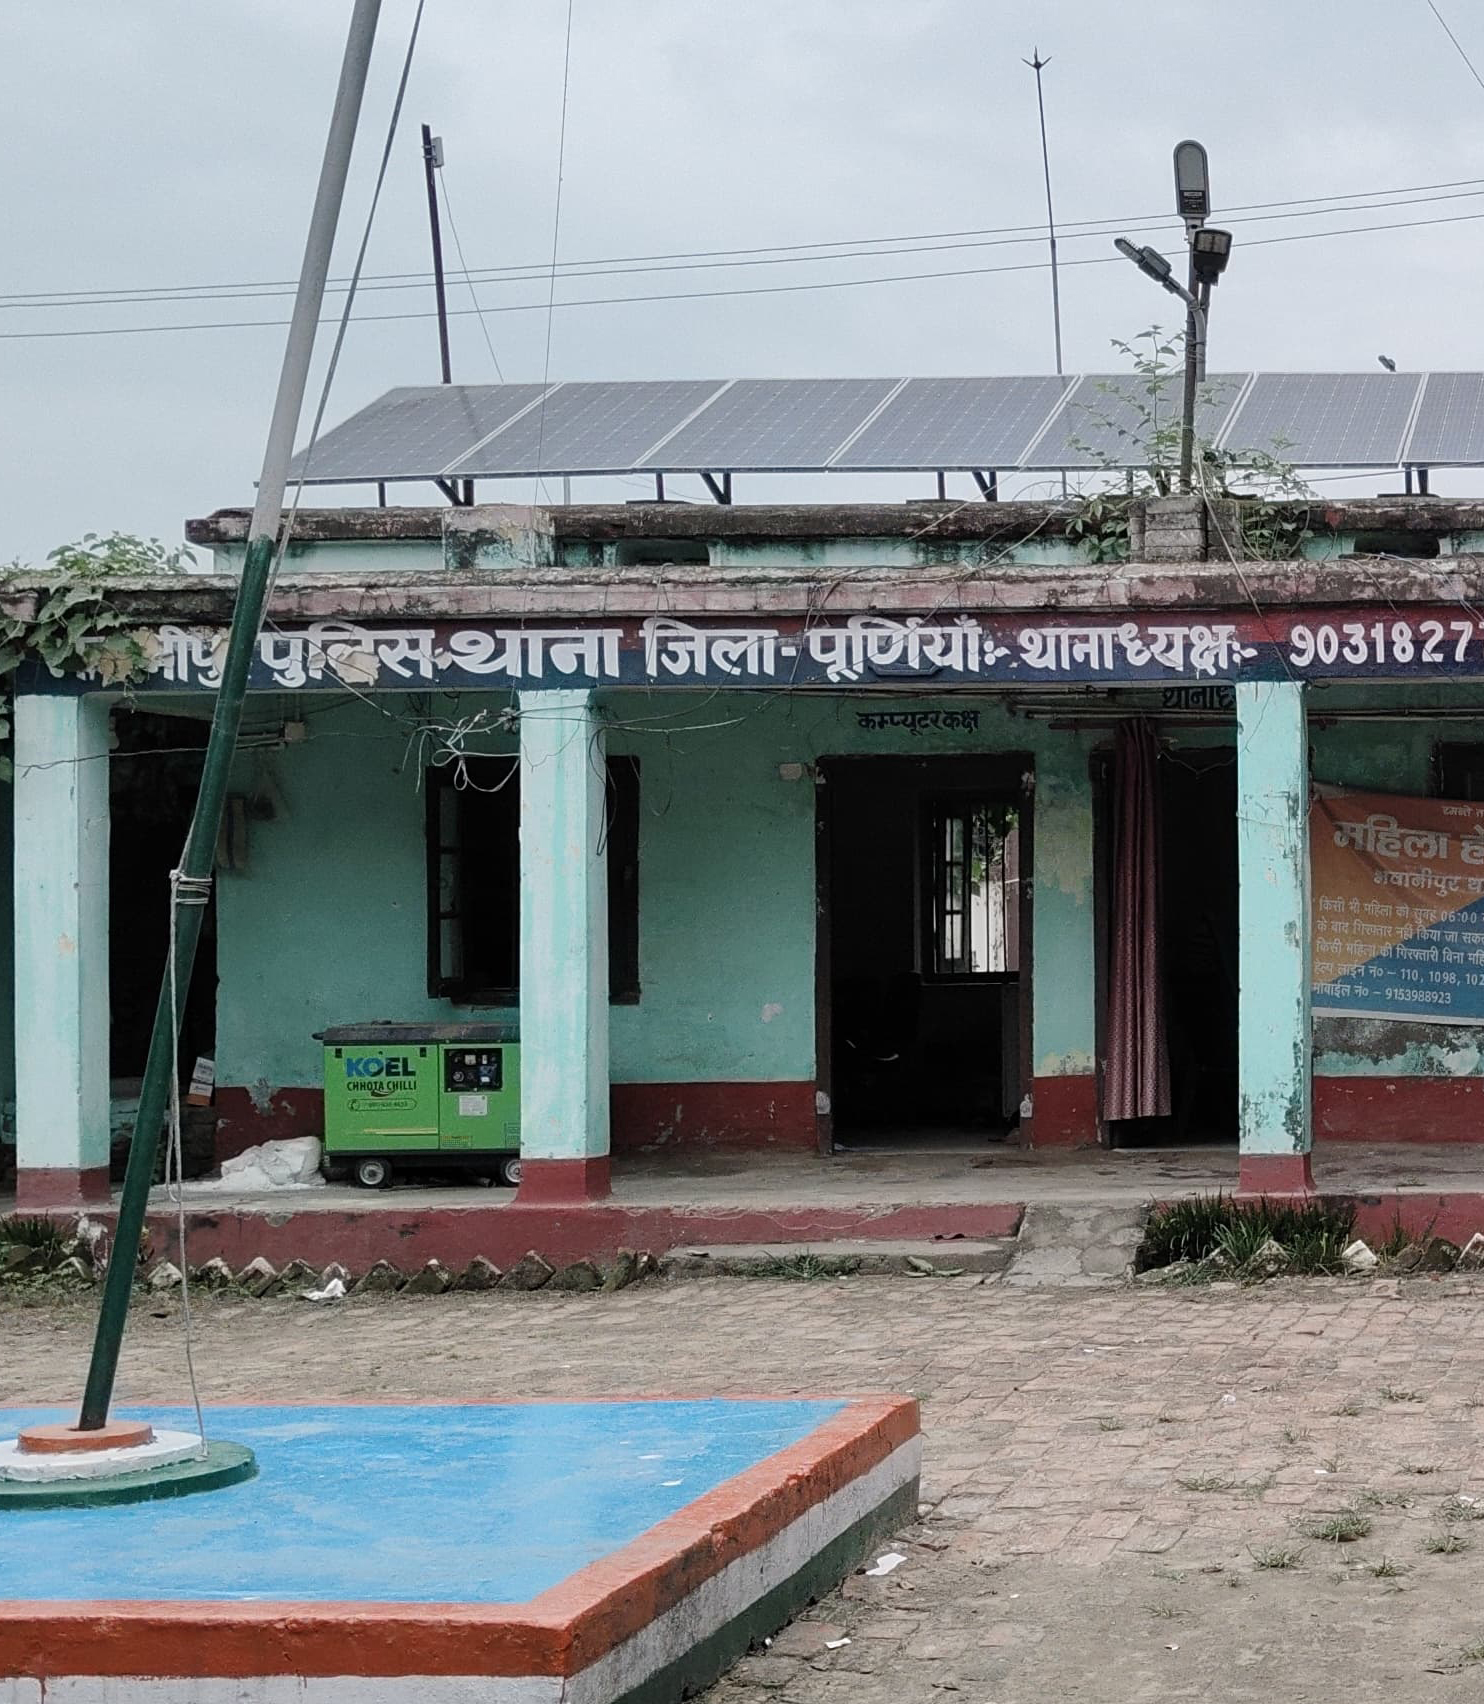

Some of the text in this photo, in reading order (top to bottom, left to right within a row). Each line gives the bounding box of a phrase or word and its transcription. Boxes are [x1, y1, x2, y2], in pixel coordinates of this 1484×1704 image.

[450, 628, 623, 678] थाना
[1333, 814, 1450, 859] महिला
[1441, 911, 1477, 924] 06:00
[1317, 917, 1328, 933] के
[1417, 925, 1440, 942] किया
[1444, 931, 1458, 943] जा
[347, 1057, 416, 1077] KOEL
[347, 1080, 417, 1092] CHHOTA CHILLI
